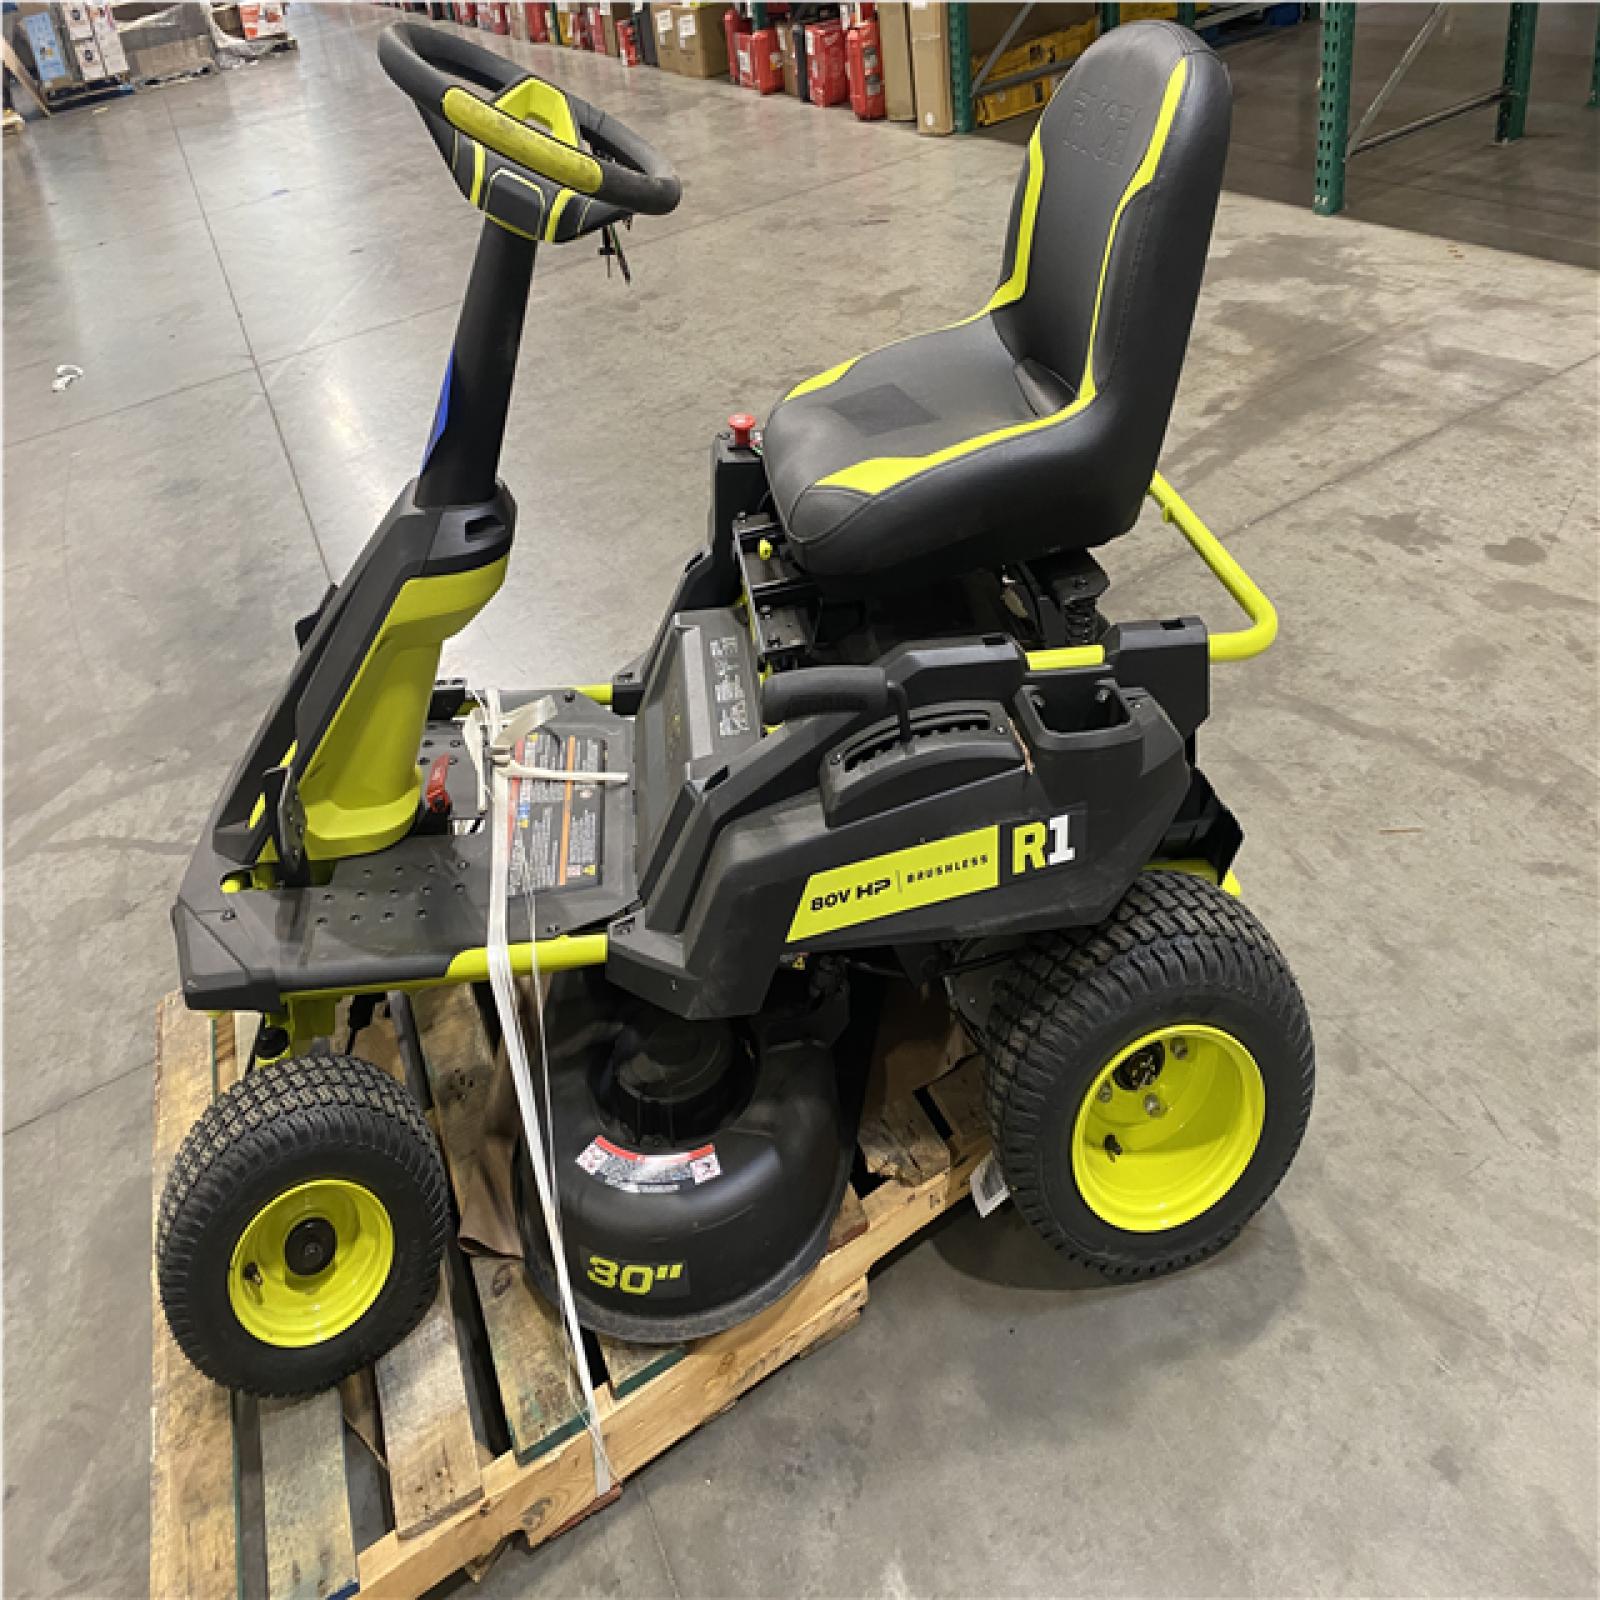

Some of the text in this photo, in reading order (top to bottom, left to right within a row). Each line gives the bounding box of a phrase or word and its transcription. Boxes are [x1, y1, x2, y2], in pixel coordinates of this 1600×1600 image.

[1013, 815, 1075, 875] R1
[810, 855, 988, 912] 80V HP BRUSHLESS
